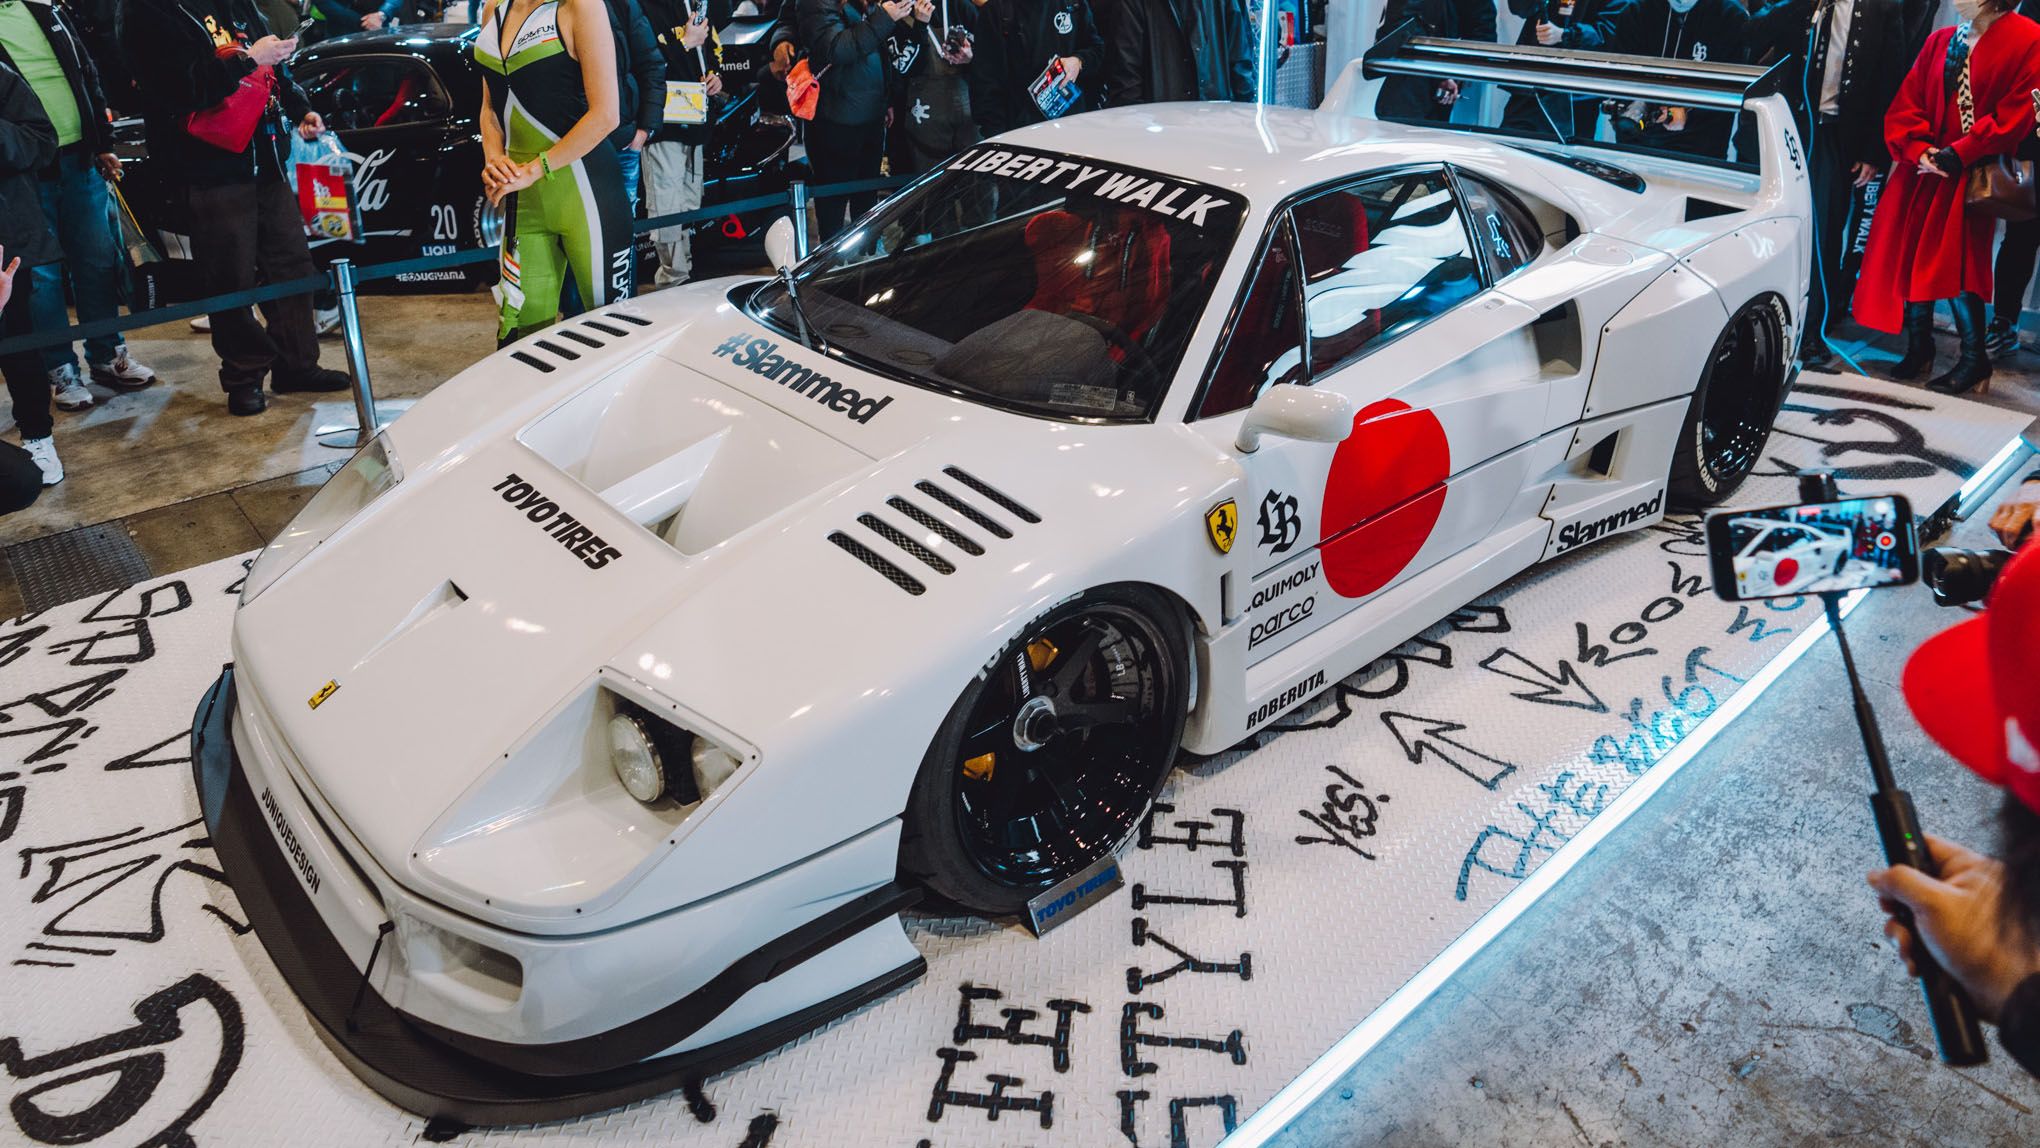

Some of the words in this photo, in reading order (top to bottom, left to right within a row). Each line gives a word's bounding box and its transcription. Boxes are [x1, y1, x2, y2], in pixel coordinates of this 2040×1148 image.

[947, 149, 1105, 190] LIBERTY
[1094, 171, 1231, 228] WALK
[430, 204, 458, 240] 20
[1853, 218, 1873, 254] WALK
[711, 331, 895, 425] #Slammed
[491, 472, 561, 524] TOYO
[541, 511, 624, 570] TIRES
[1556, 488, 1665, 553] Slammed
[1248, 596, 1316, 651] parco
[1294, 764, 1391, 861] YES!
[1036, 890, 1077, 923] TOYO
